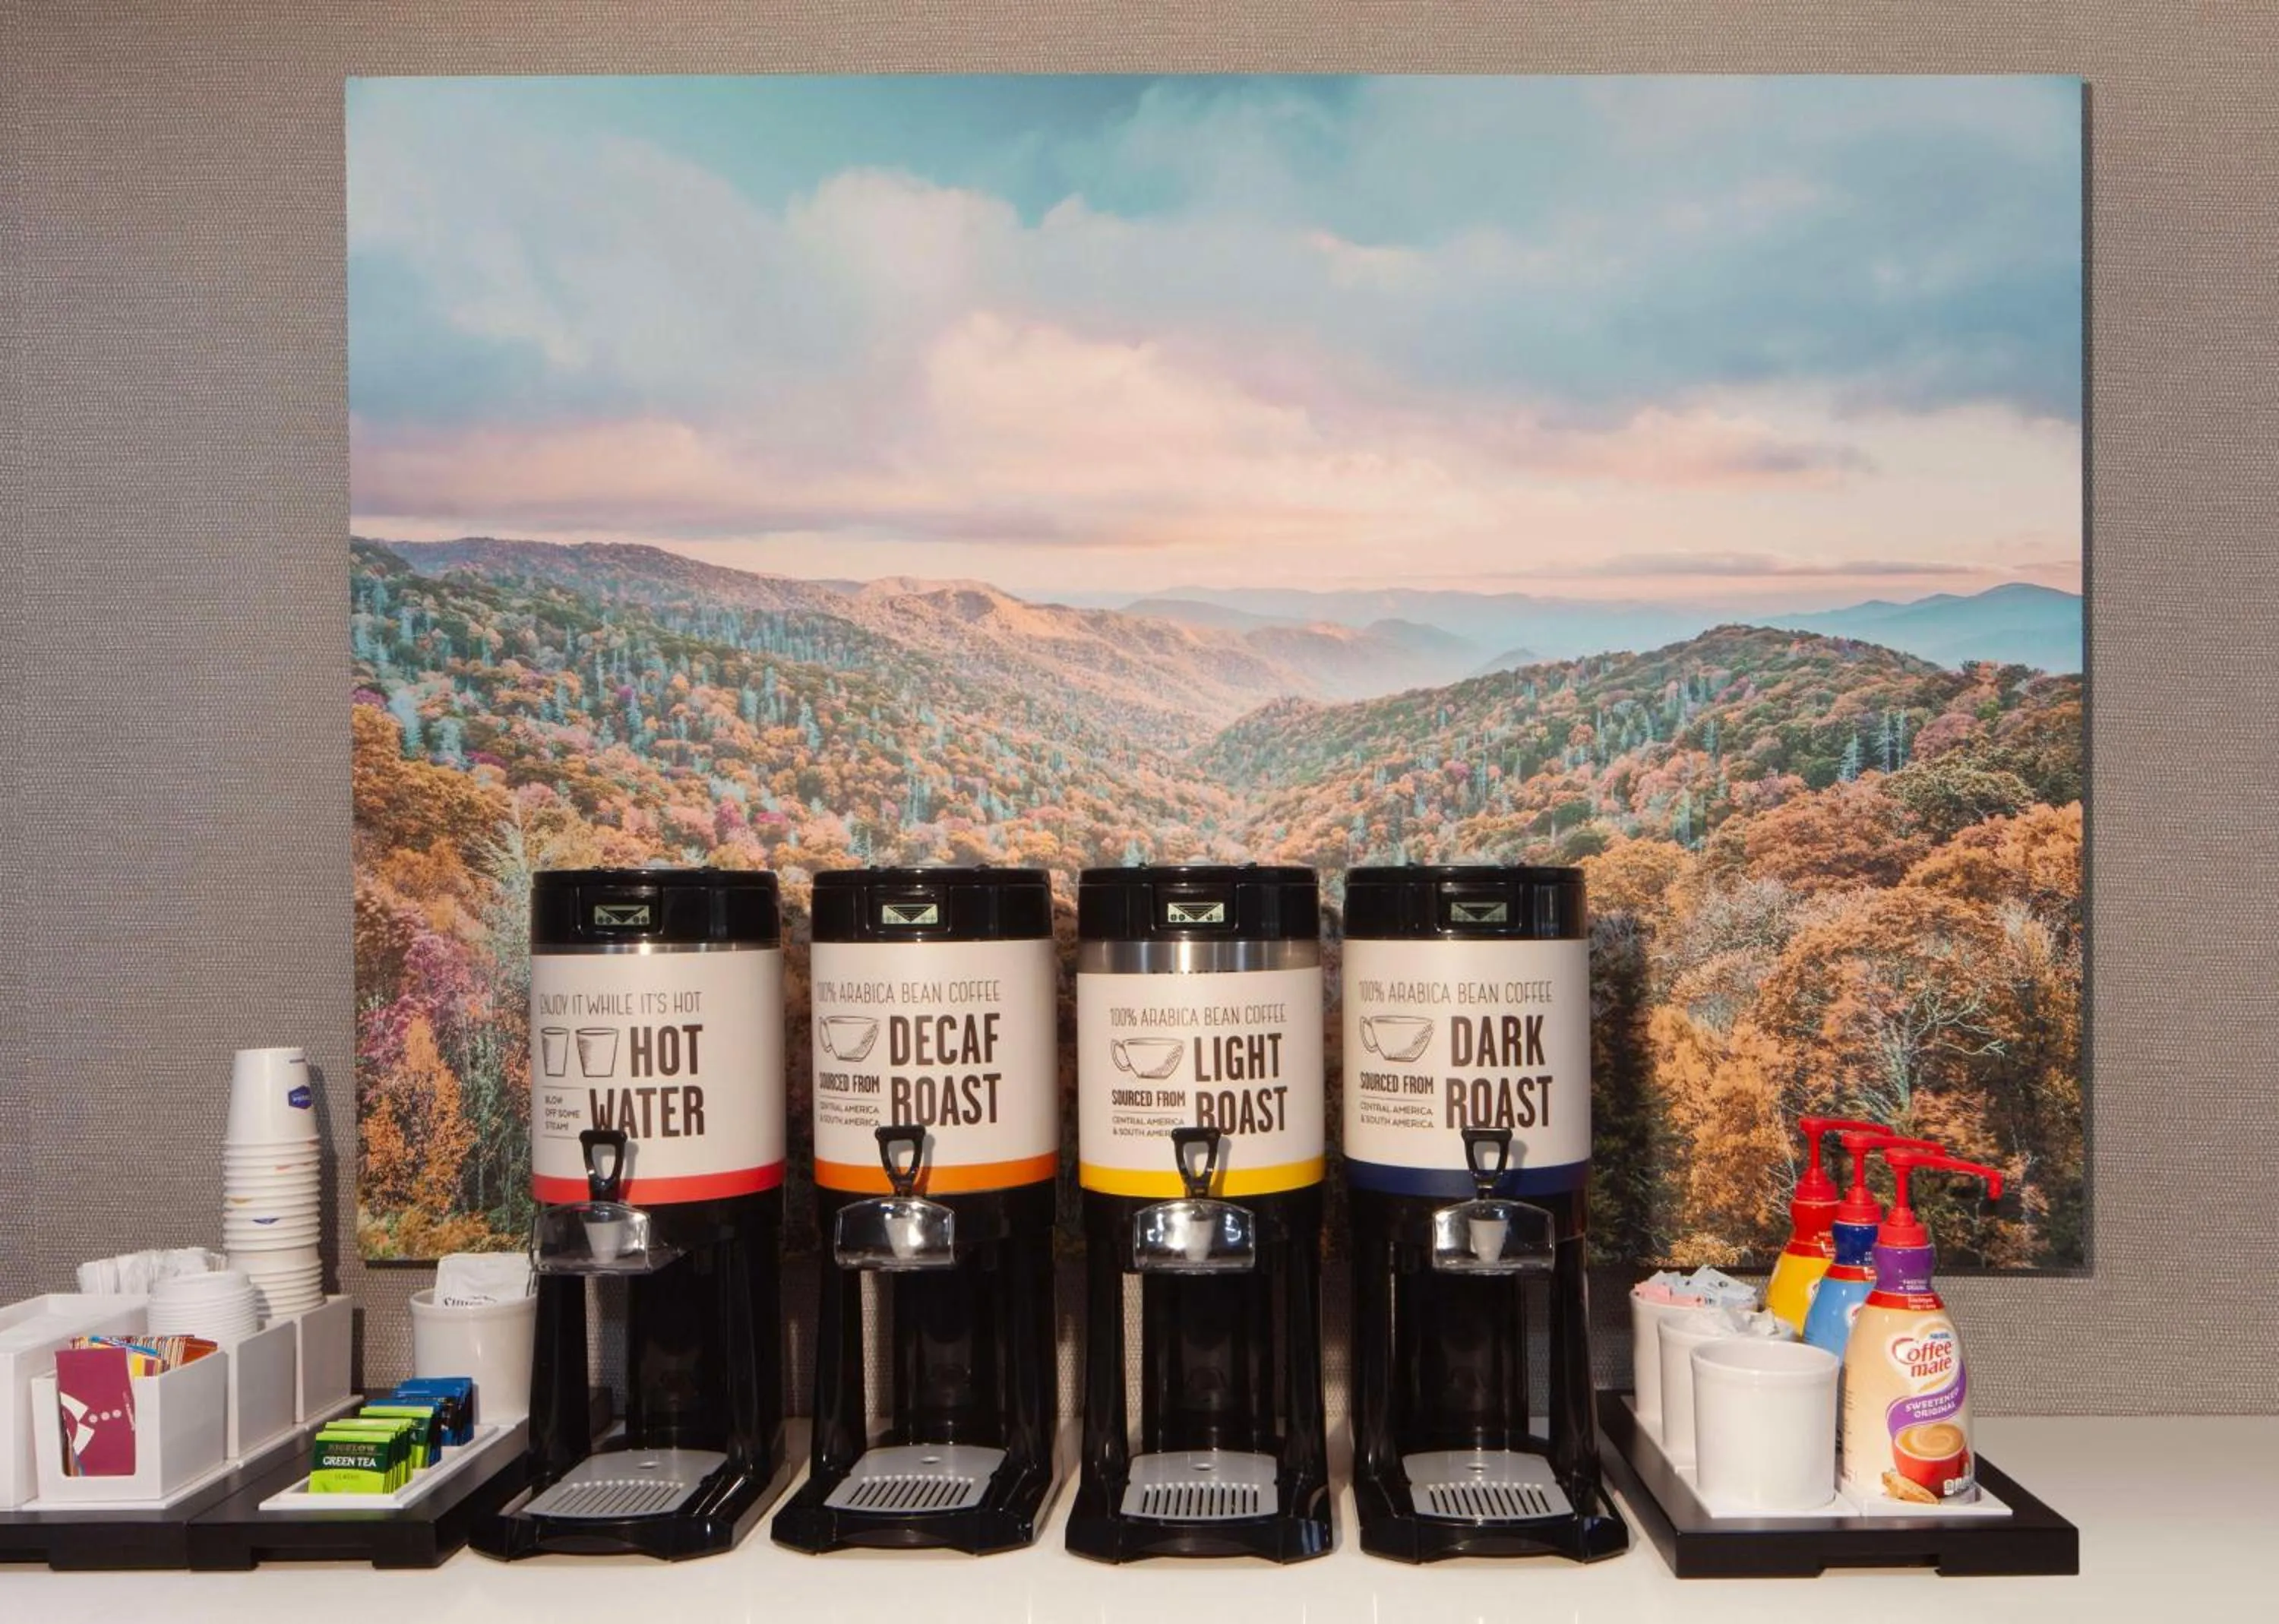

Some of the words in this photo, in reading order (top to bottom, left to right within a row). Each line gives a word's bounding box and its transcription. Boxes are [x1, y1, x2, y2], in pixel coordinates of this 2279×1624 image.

[839, 981, 895, 1003] ARABICA
[902, 981, 942, 1003] BEAN
[950, 980, 1001, 1003] COFFEE
[1359, 981, 1385, 1003] 100%
[1388, 982, 1451, 1003] ARABICA
[1458, 982, 1499, 1004] BEAN
[1505, 981, 1553, 1003] COFFEE
[539, 994, 568, 1016] ENJOY
[572, 994, 583, 1015] IT
[586, 993, 634, 1015] WHILE
[640, 992, 667, 1015] IT'S
[674, 991, 703, 1013] HOT
[1110, 1006, 1137, 1025] 100%
[1139, 1007, 1200, 1026] ARABICA
[1204, 1006, 1240, 1026] BEAN
[1244, 1003, 1288, 1025] COFFEE
[630, 1024, 703, 1078] HOT
[890, 1013, 1000, 1066] DECAF
[1451, 1014, 1546, 1067] DARK
[1193, 1032, 1282, 1082] LIGHT
[853, 1074, 880, 1094] FROM
[1360, 1071, 1399, 1093] SOURCED
[1402, 1074, 1434, 1095] FROM
[890, 1073, 1002, 1127] ROAST
[1111, 1088, 1153, 1107] SOURCED
[1156, 1090, 1186, 1107] FROM
[1445, 1075, 1554, 1130] ROAST
[589, 1085, 705, 1139] WATER
[844, 1105, 880, 1115] AMERICA
[1111, 1115, 1145, 1126] CENTRAL
[1146, 1117, 1185, 1126] AMERICA
[1195, 1085, 1288, 1136] ROAST
[1392, 1105, 1433, 1117] AMERICA
[1119, 1128, 1145, 1136] SOUTH
[1146, 1129, 1171, 1137] AMER
[1392, 1118, 1434, 1129] AMERICA
[1892, 1337, 1952, 1365] Coffee
[1910, 1357, 1952, 1378] mate
[1914, 1401, 1956, 1418] ORIGINAL
[323, 1456, 356, 1467] GREEN
[357, 1457, 377, 1468] TEA
